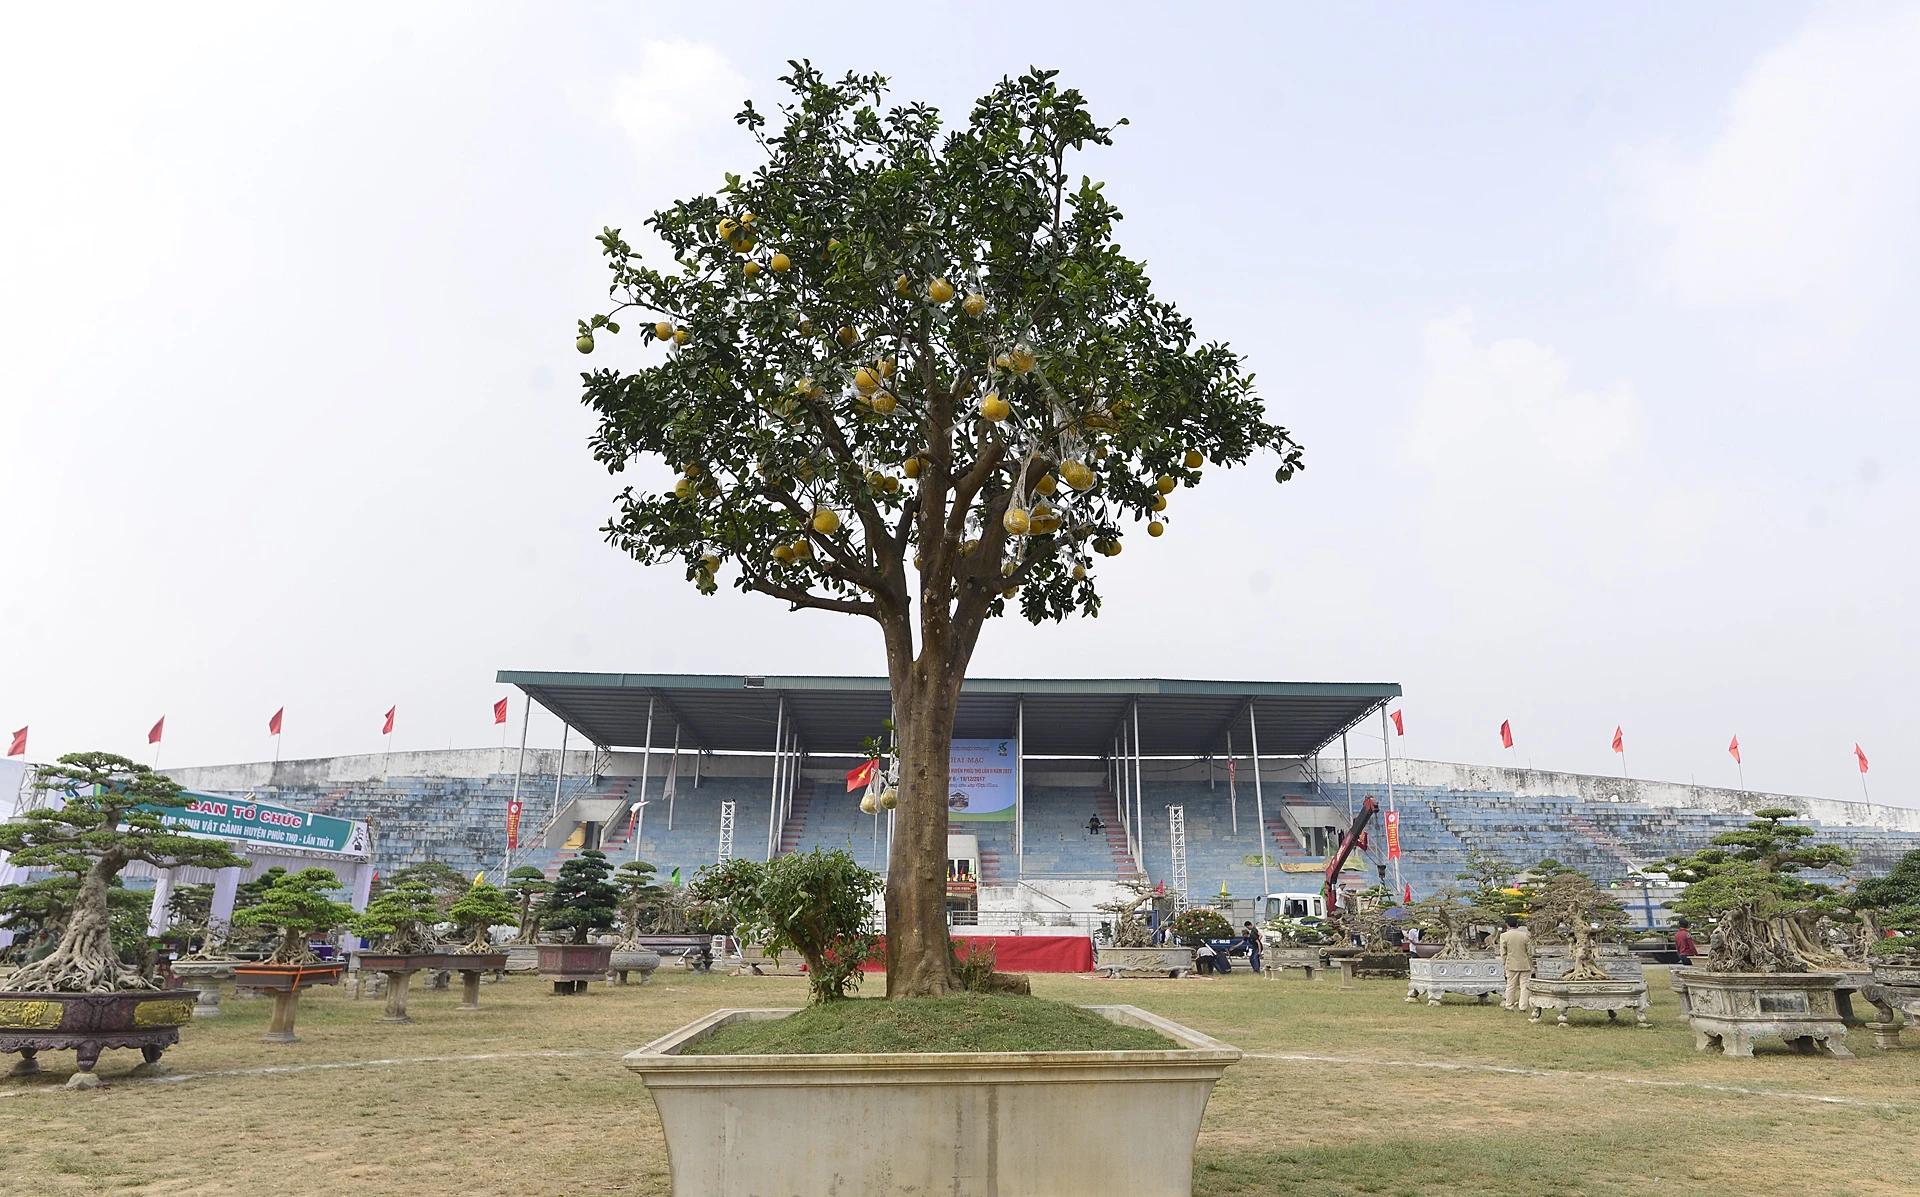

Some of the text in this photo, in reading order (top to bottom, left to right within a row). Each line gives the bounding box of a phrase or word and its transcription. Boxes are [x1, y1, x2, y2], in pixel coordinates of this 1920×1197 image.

[185, 800, 302, 829] BAN TỔ CHỨC
[202, 819, 218, 834] VẬT
[220, 820, 242, 835] CẢNH
[243, 826, 267, 839] HUYỆN
[266, 829, 285, 841] PHÚC
[286, 832, 298, 845] THỌ
